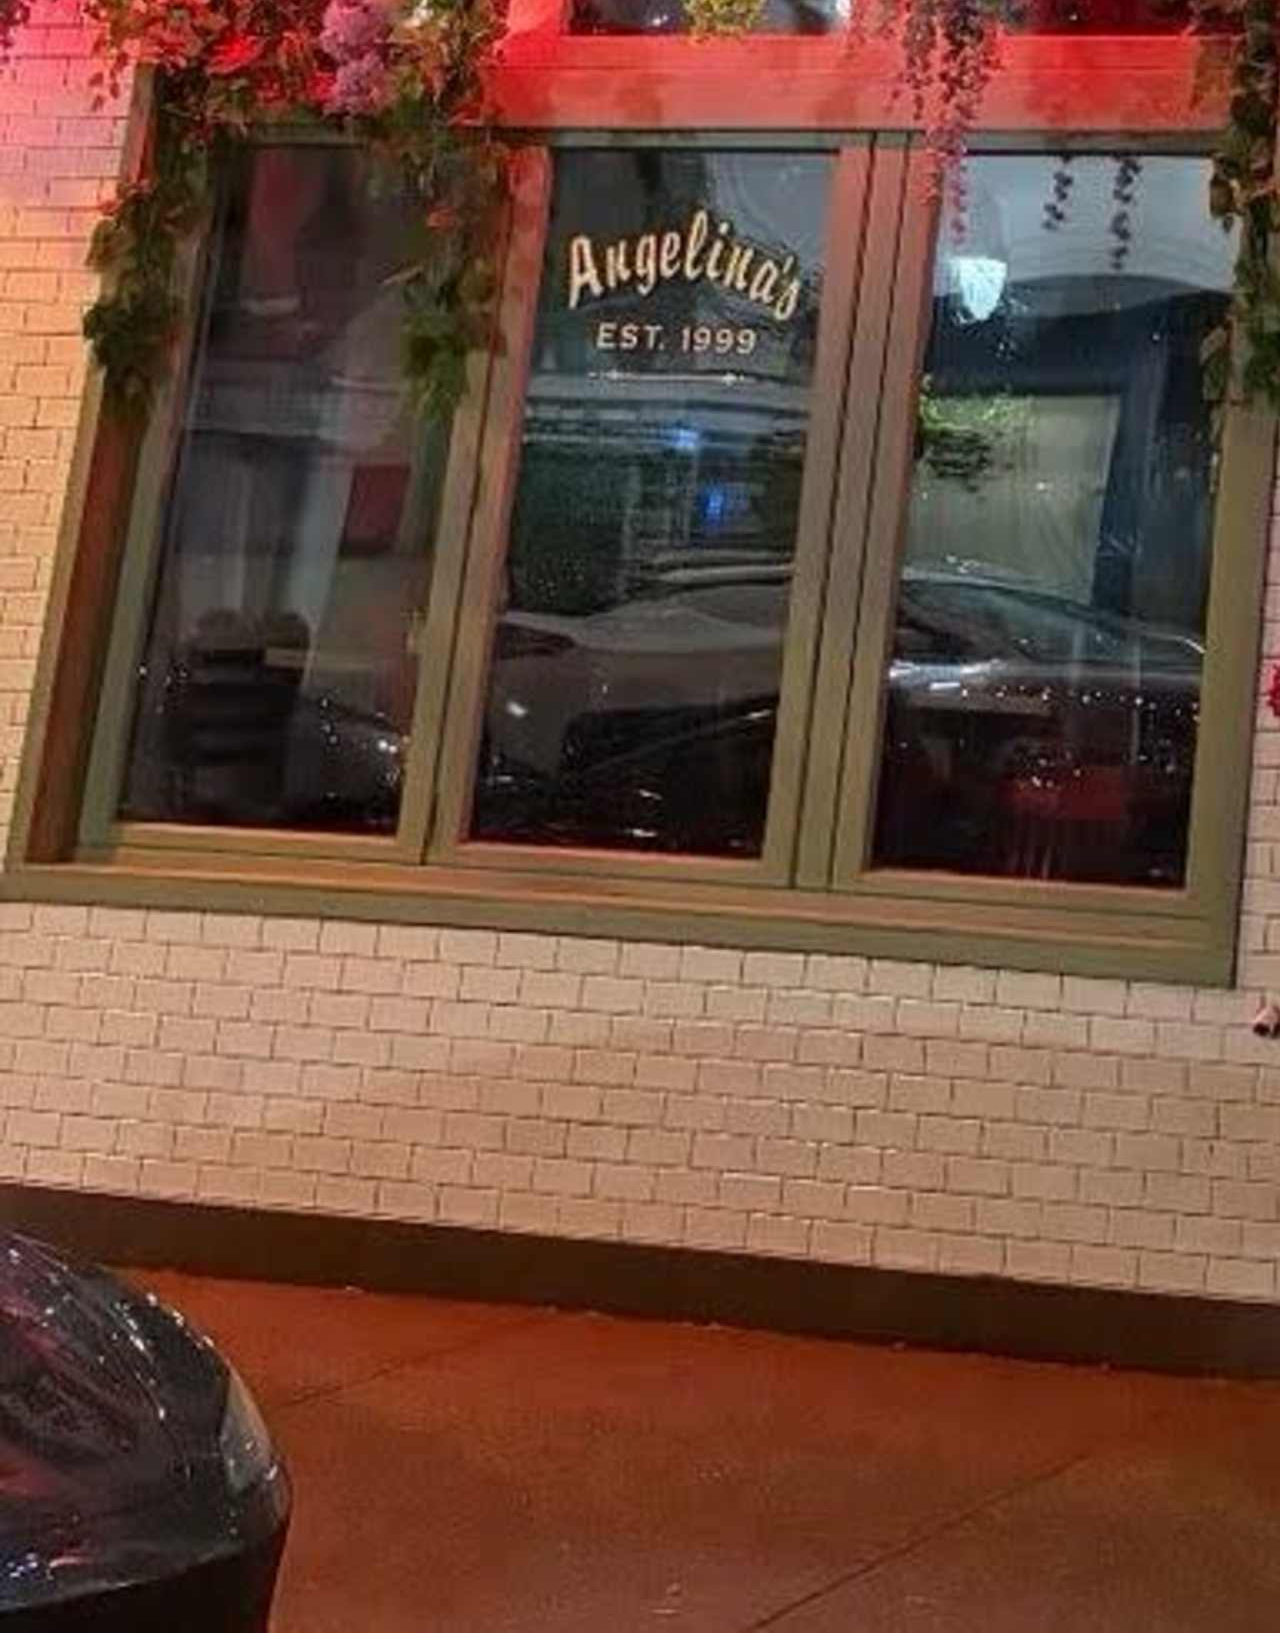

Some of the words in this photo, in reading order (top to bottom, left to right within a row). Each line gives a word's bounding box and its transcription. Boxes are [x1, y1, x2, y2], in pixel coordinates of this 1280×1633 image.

[567, 208, 802, 322] Angelina's
[596, 321, 665, 351] EST.
[681, 324, 757, 355] 1999
